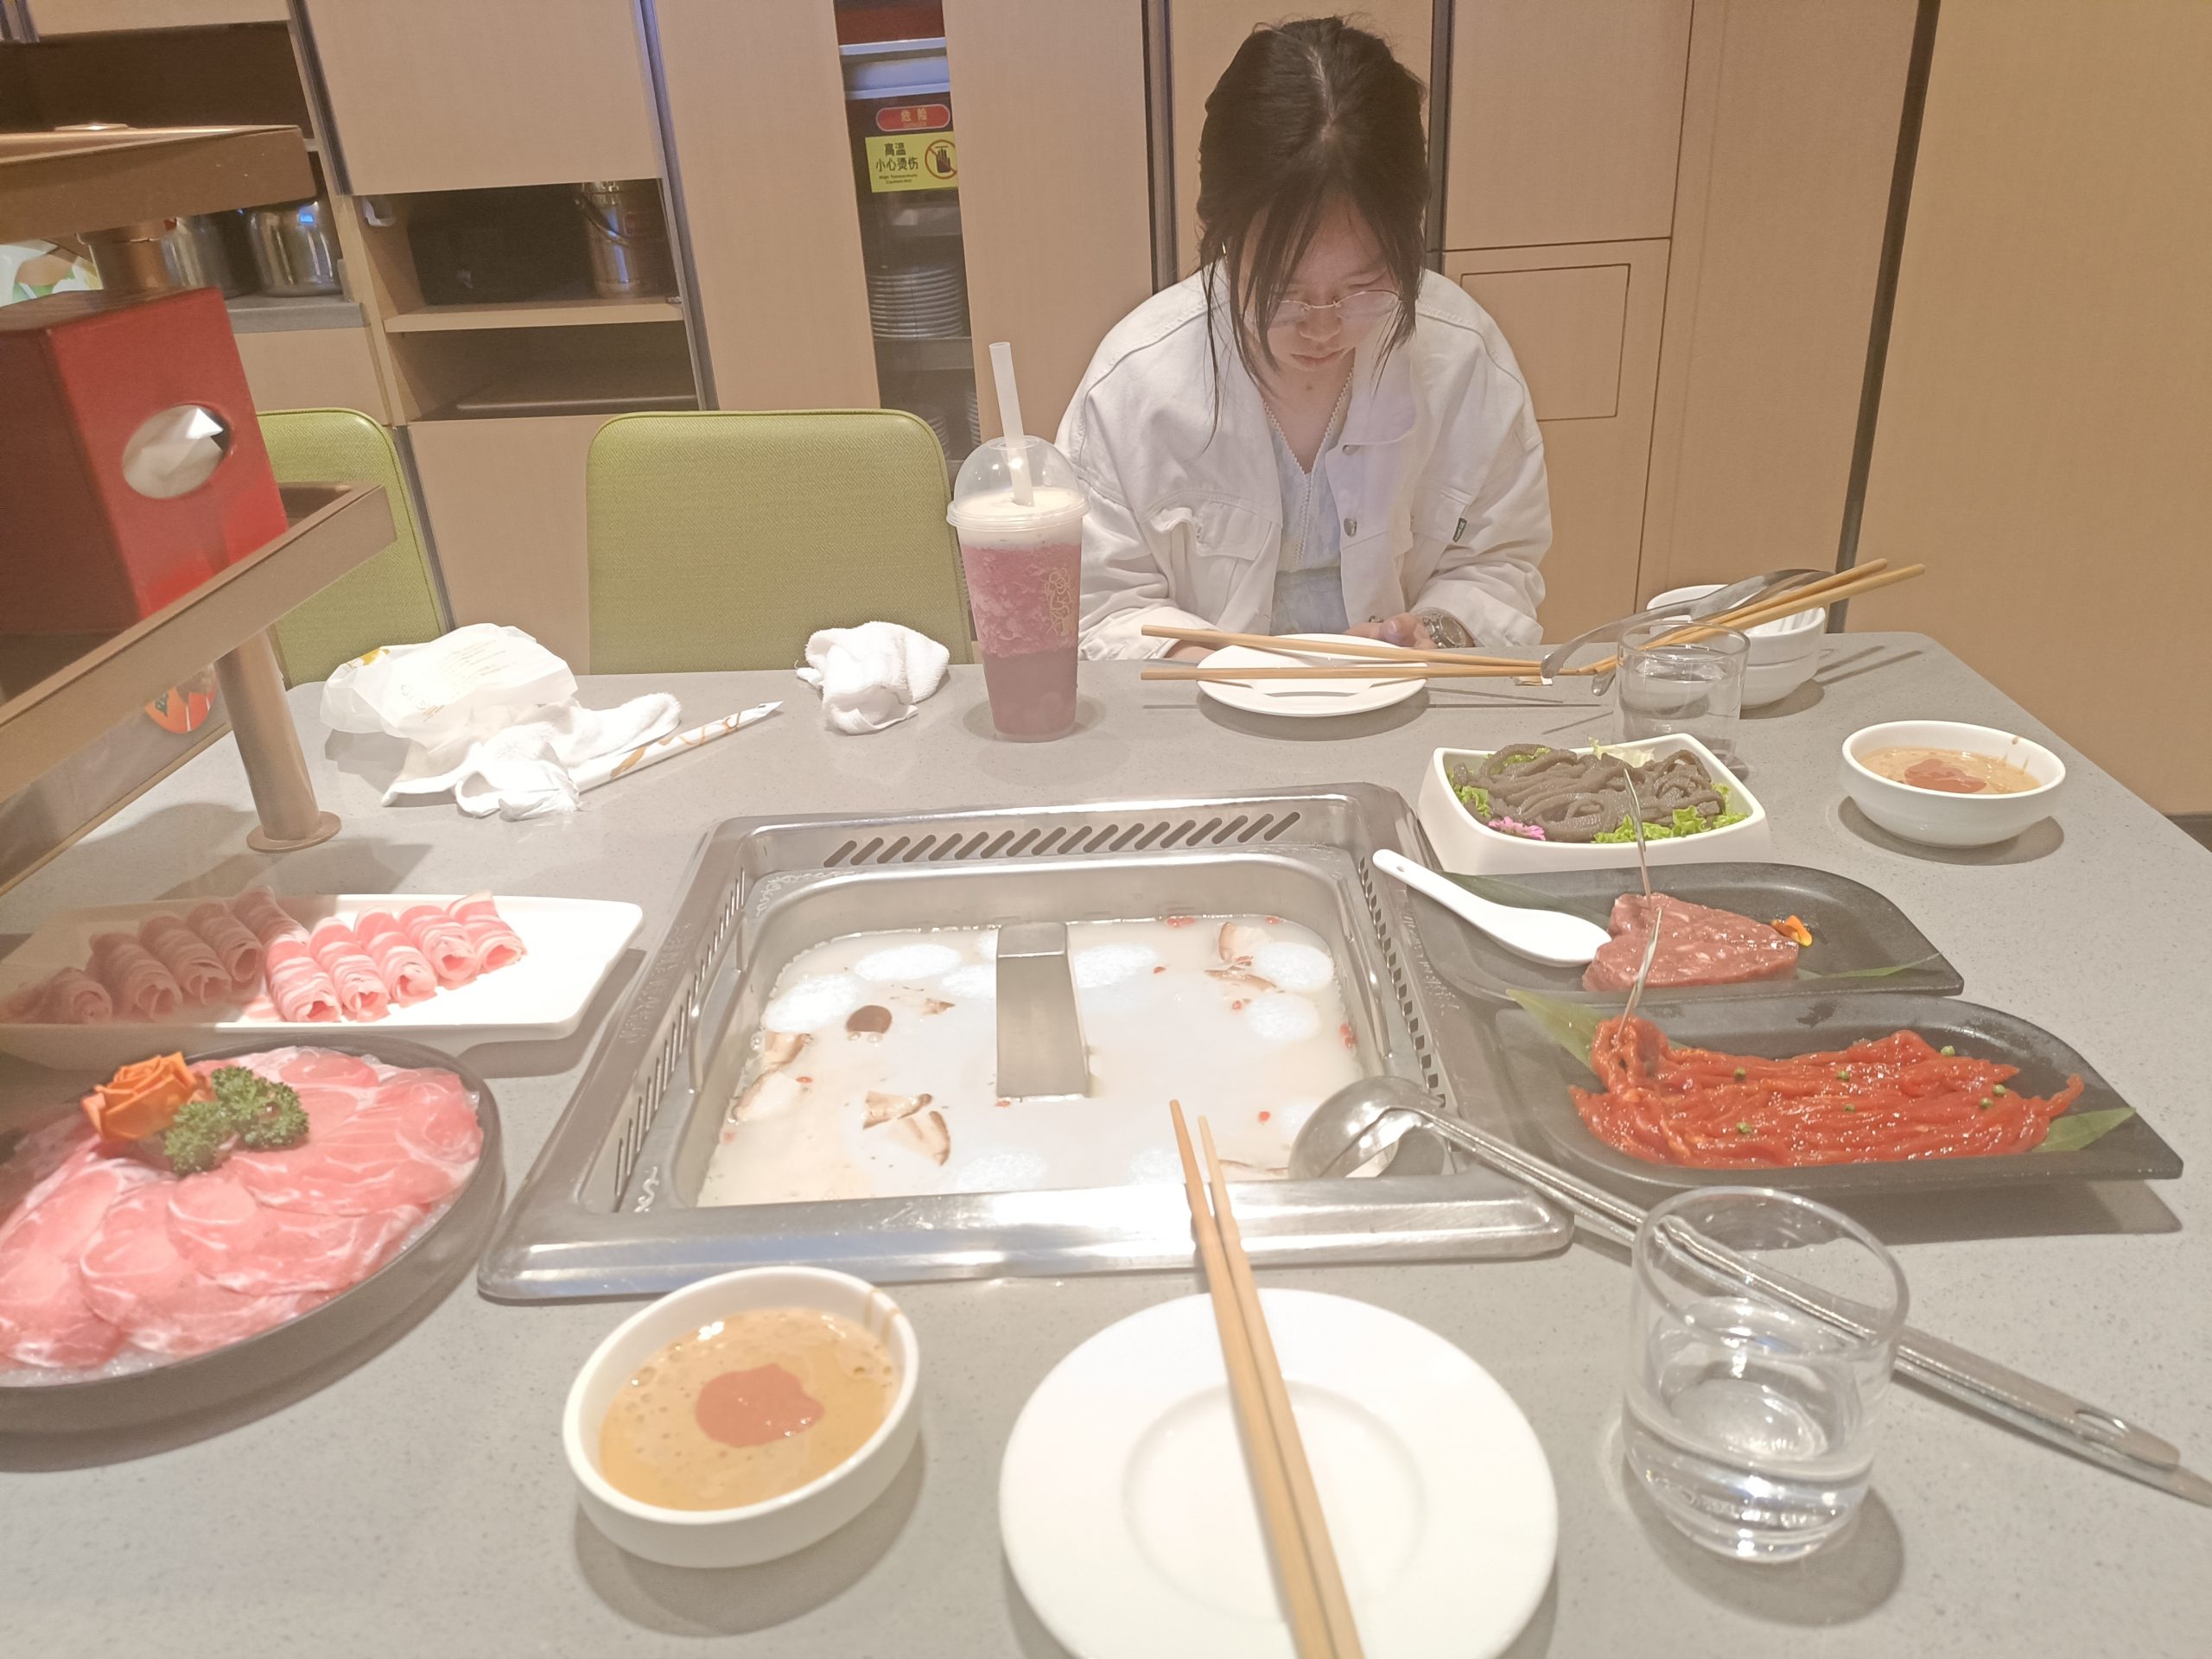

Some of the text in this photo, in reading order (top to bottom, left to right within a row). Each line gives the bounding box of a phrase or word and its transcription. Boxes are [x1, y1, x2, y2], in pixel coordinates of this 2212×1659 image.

[884, 142, 906, 156] 高温
[875, 156, 918, 172] 小心烫伤
